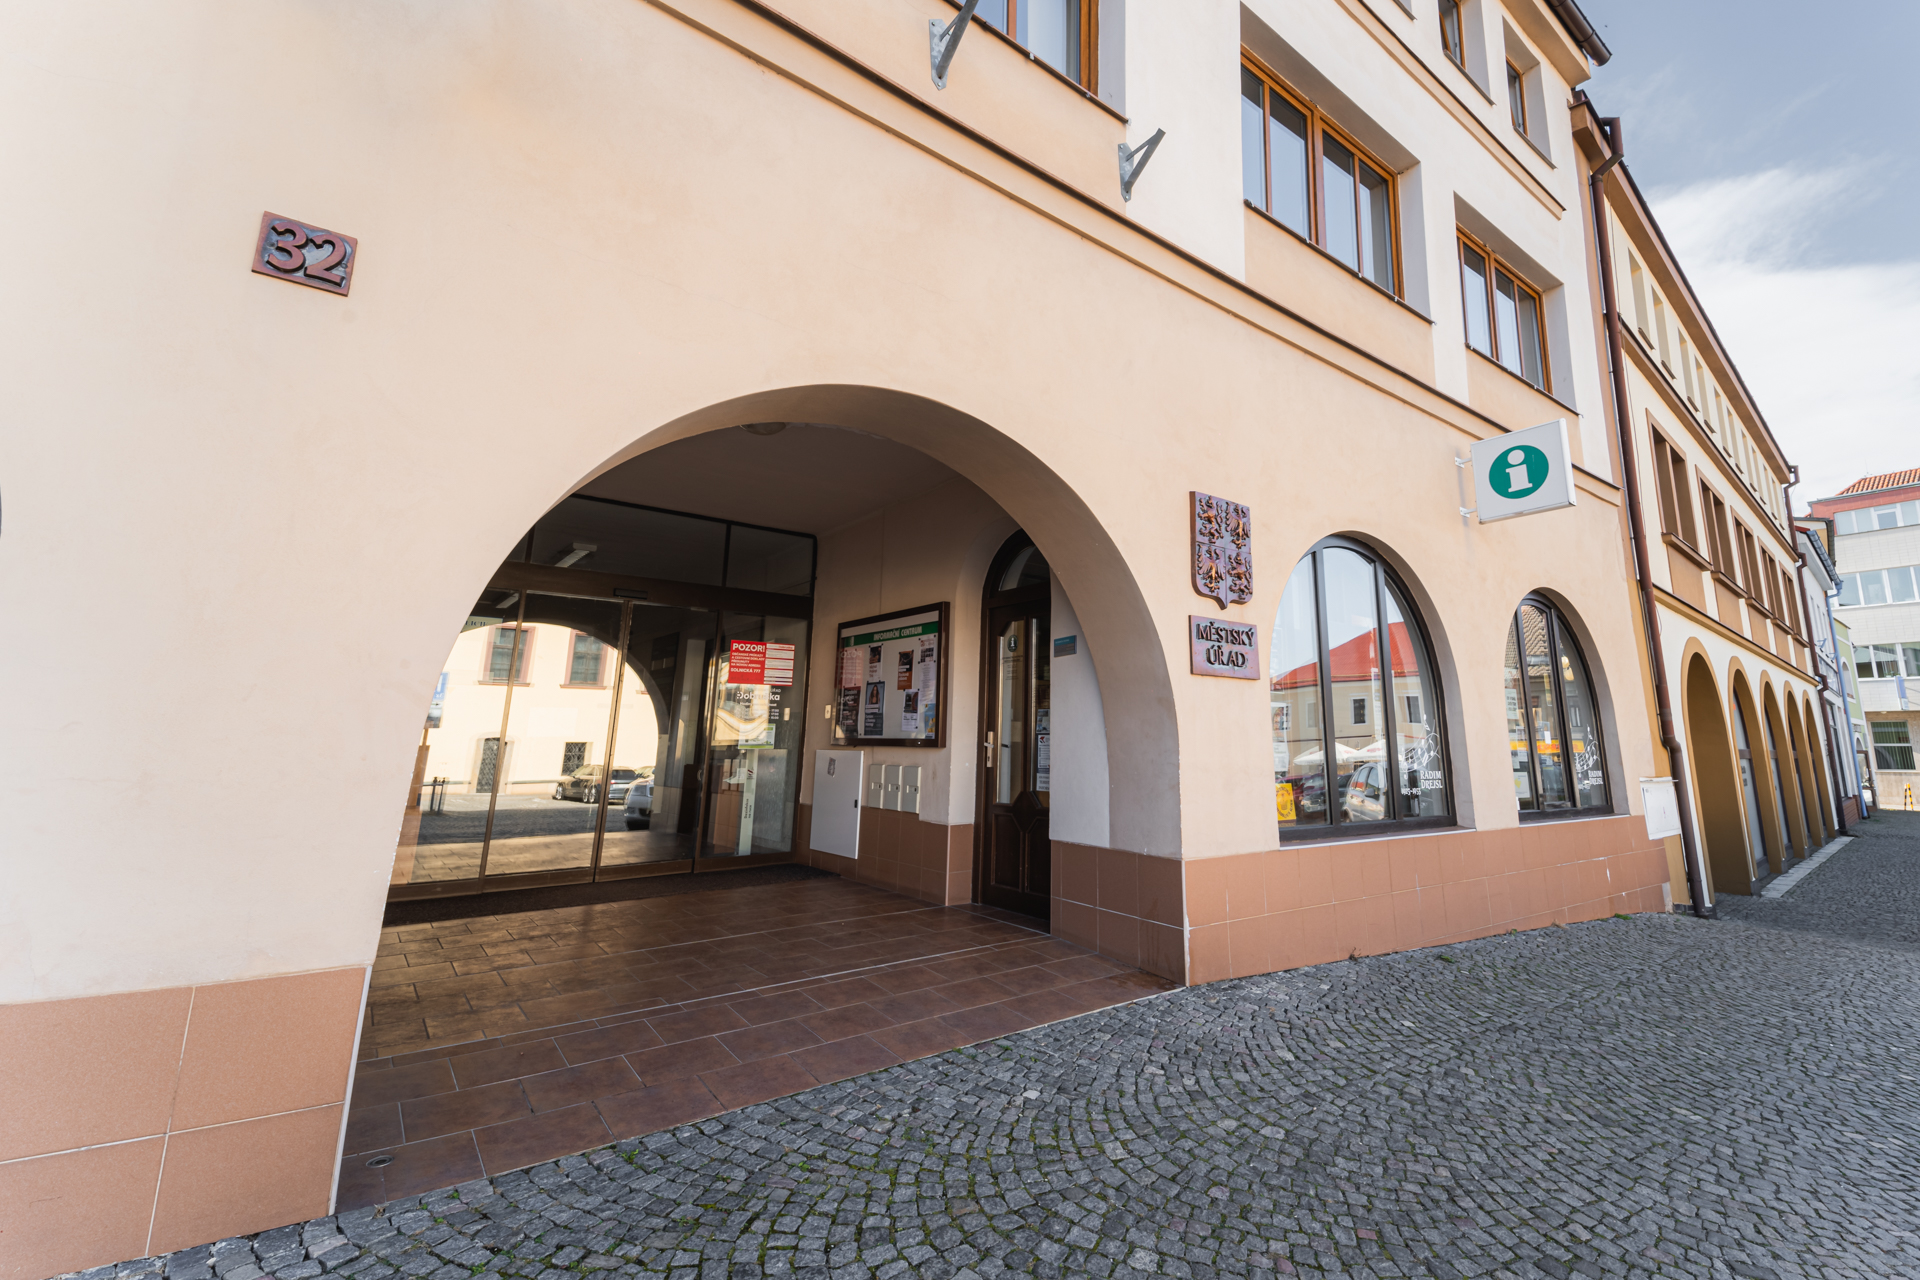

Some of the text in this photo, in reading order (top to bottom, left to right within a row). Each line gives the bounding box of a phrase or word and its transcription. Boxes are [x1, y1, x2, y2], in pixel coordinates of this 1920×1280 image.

[265, 221, 346, 287] 32
[873, 626, 923, 641] INFORMAČNÍ CENTRUM
[1195, 621, 1255, 647] MĚSTSKÝ
[732, 643, 766, 652] POZOR!
[1205, 644, 1247, 668] ÚŘAD
[1420, 770, 1442, 780] RADIM
[1421, 779, 1443, 790] DREJSL
